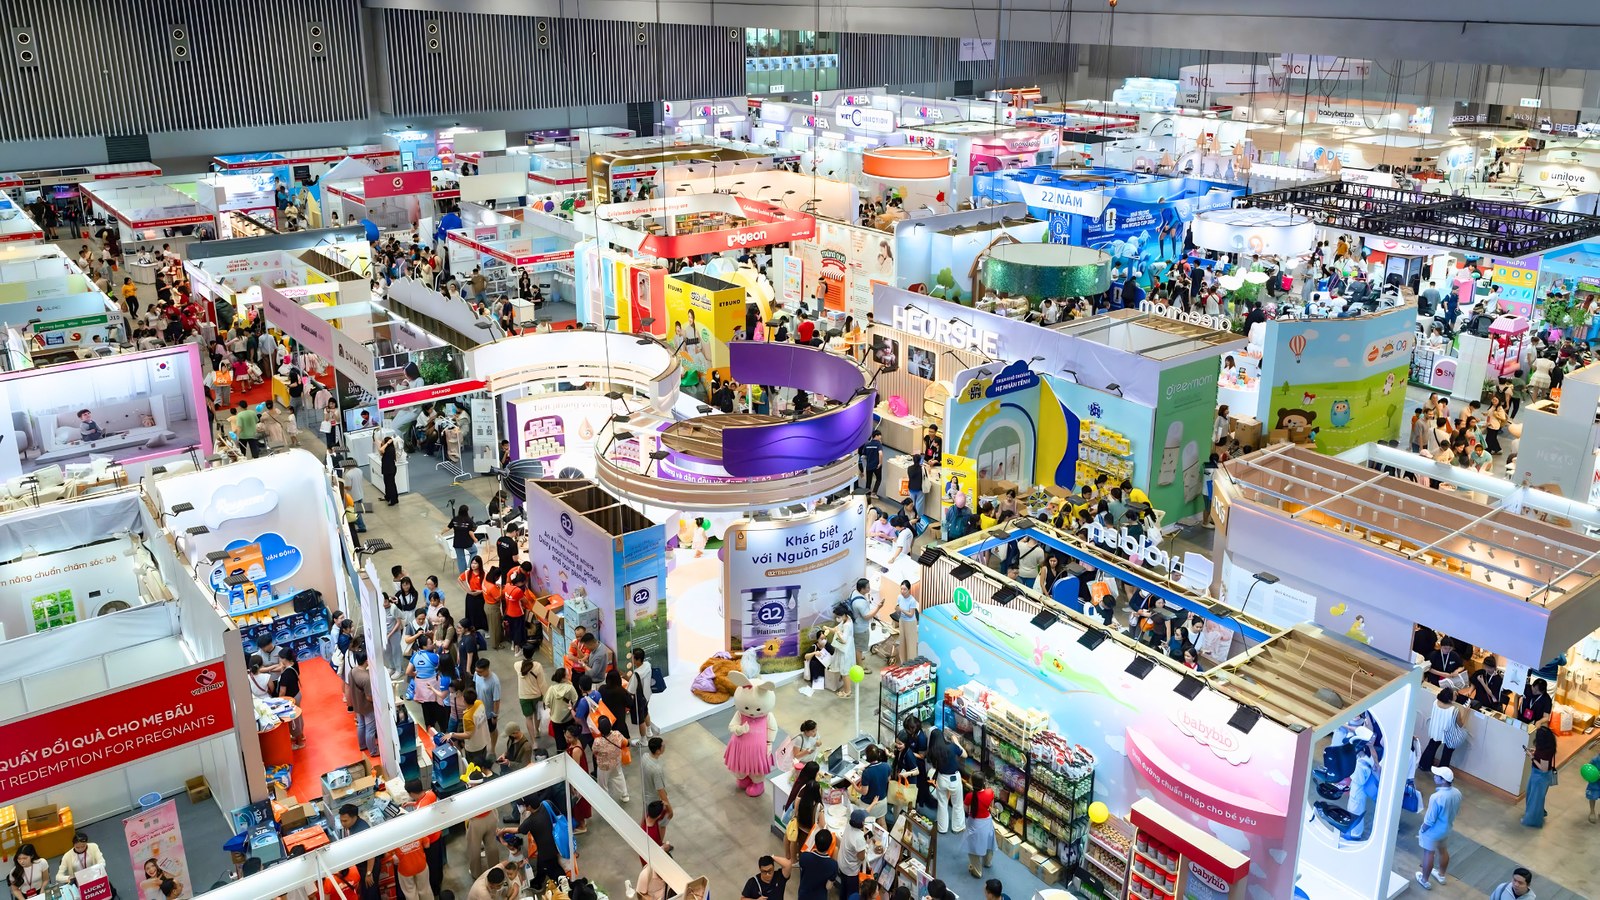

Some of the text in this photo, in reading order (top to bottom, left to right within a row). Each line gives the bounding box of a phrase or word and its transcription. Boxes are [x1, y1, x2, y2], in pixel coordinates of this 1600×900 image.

[842, 95, 870, 106] KOREA
[696, 104, 730, 117] KOREA
[914, 106, 944, 119] KOREA
[802, 114, 830, 129] KOREA
[1551, 172, 1585, 183] unilove
[1042, 190, 1083, 208] 22 NĂM
[727, 230, 766, 246] pigeon
[1166, 374, 1213, 400] greenmom
[684, 472, 696, 483] dẫn
[786, 525, 839, 547] Khác biệt
[539, 534, 551, 550] Dairy
[552, 546, 576, 568] nourishes
[584, 569, 601, 586] people
[566, 548, 580, 560] world
[752, 552, 772, 564] với
[777, 546, 818, 564] Nguồn
[822, 540, 840, 554] Sữa
[571, 567, 587, 585] planet
[761, 607, 782, 620] a2
[42, 738, 70, 758] ĐỔI
[72, 728, 105, 748] QUÀ
[107, 720, 140, 738] CHO
[142, 712, 163, 727] MẸ
[165, 703, 194, 721] BẦU
[1183, 712, 1232, 748] babybio
[9, 714, 215, 788] REDEMPTION FOR PREGNANTS
[1161, 779, 1183, 797] chuẩn
[1184, 792, 1205, 808] Pháp
[1207, 805, 1223, 816] cho
[1226, 810, 1237, 820] bé
[1239, 816, 1256, 826] yêu
[1192, 864, 1225, 891] babybio
[83, 882, 105, 895] LUCKY
[85, 888, 106, 900] DRAW
